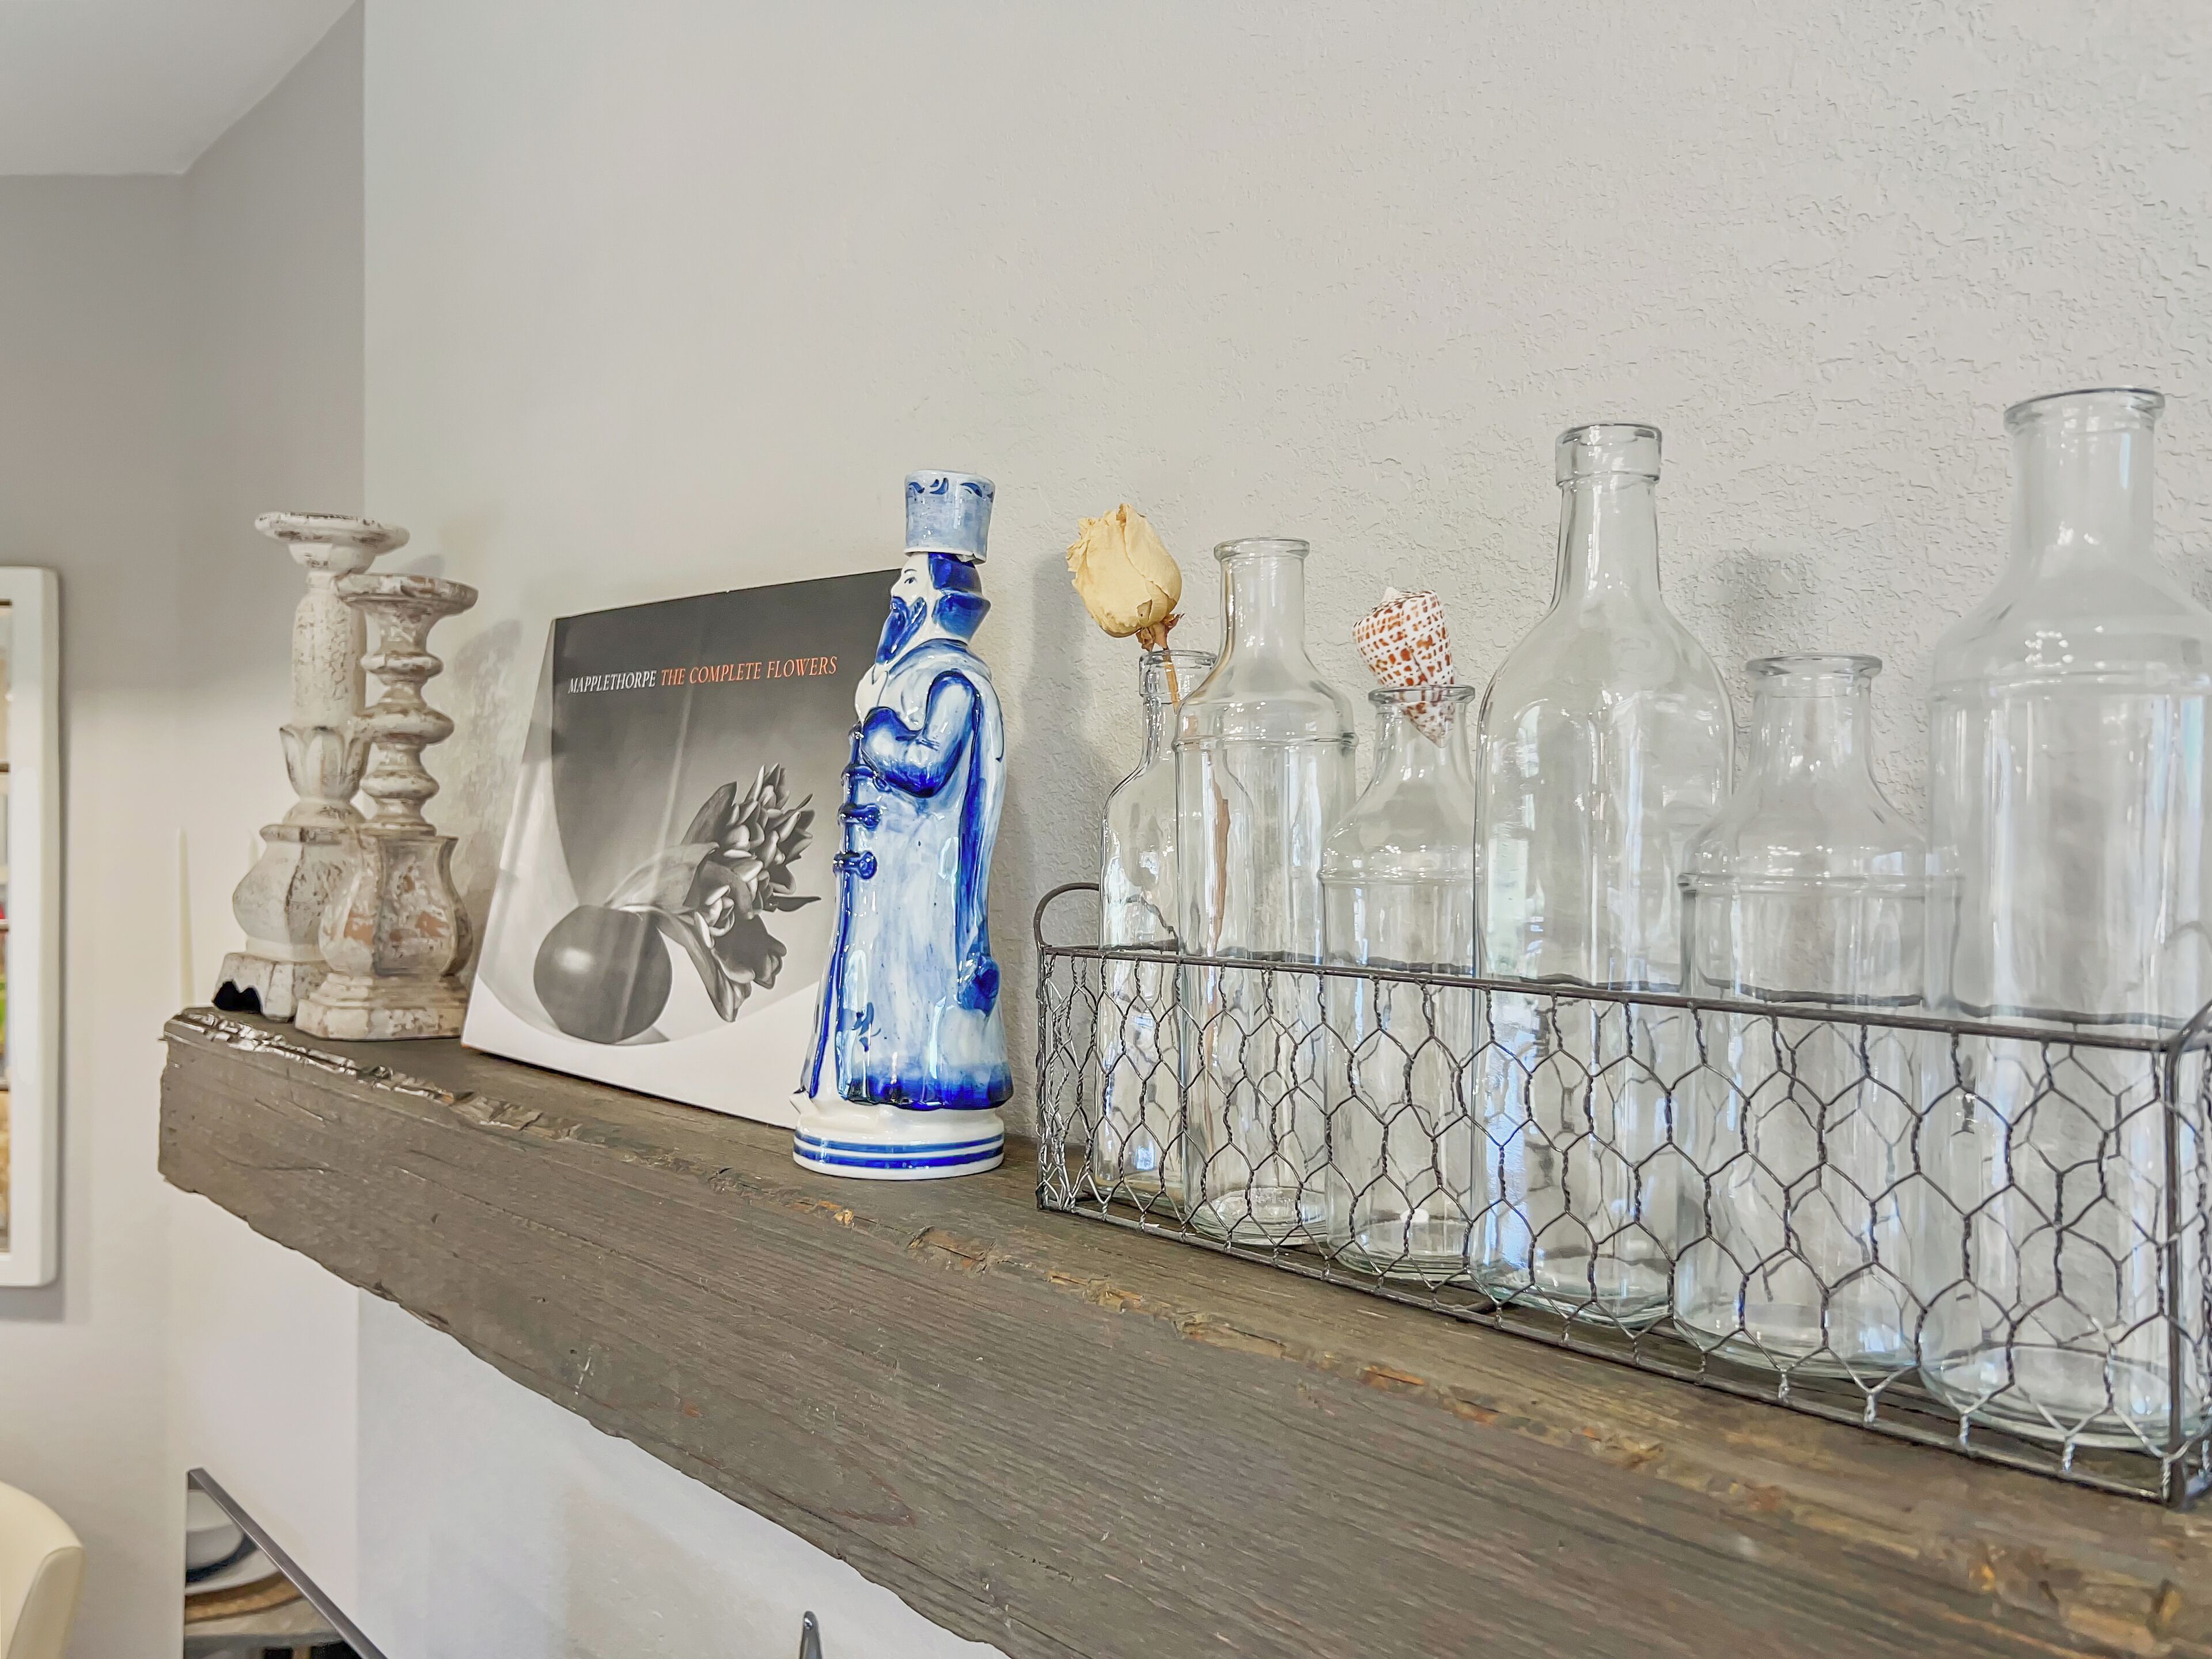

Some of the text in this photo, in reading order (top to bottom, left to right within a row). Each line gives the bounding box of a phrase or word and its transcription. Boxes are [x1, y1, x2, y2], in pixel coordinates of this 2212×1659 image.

[568, 656, 838, 694] MAPPLETHORPE THE COMPLETE FLOWERS
